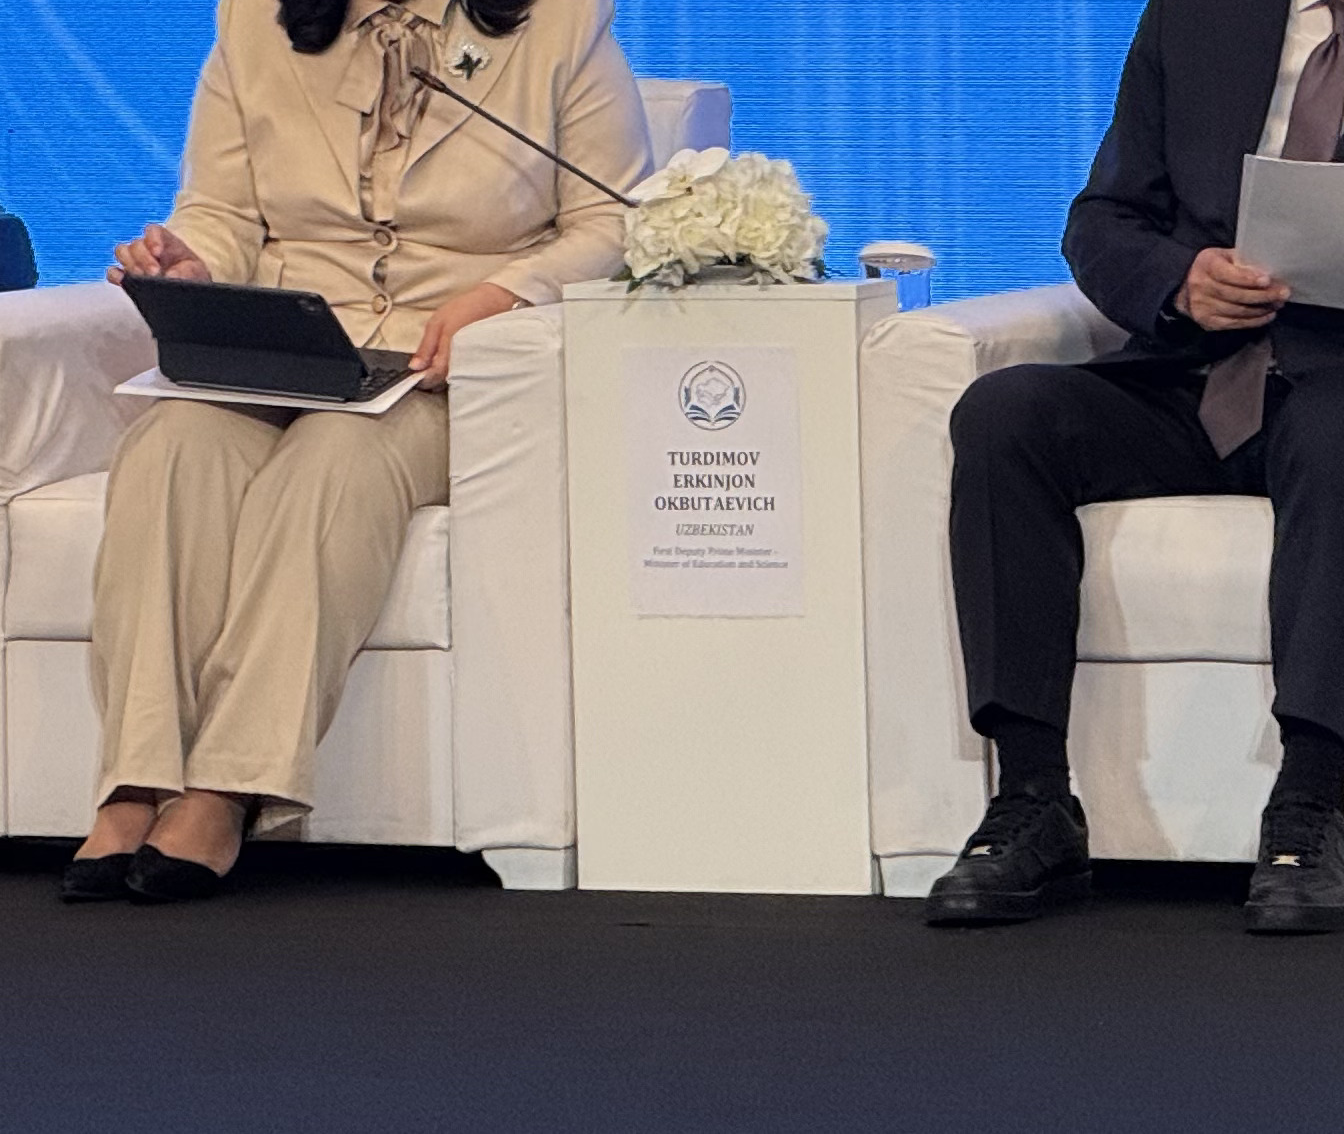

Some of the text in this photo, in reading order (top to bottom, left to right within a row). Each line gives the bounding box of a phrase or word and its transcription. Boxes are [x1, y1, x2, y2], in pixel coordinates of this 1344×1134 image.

[667, 451, 760, 466] TURDIMOV
[673, 473, 756, 491] ERKINJON
[655, 496, 775, 511] OKBUTAEVICH
[675, 523, 754, 536] UZBEKISTAN
